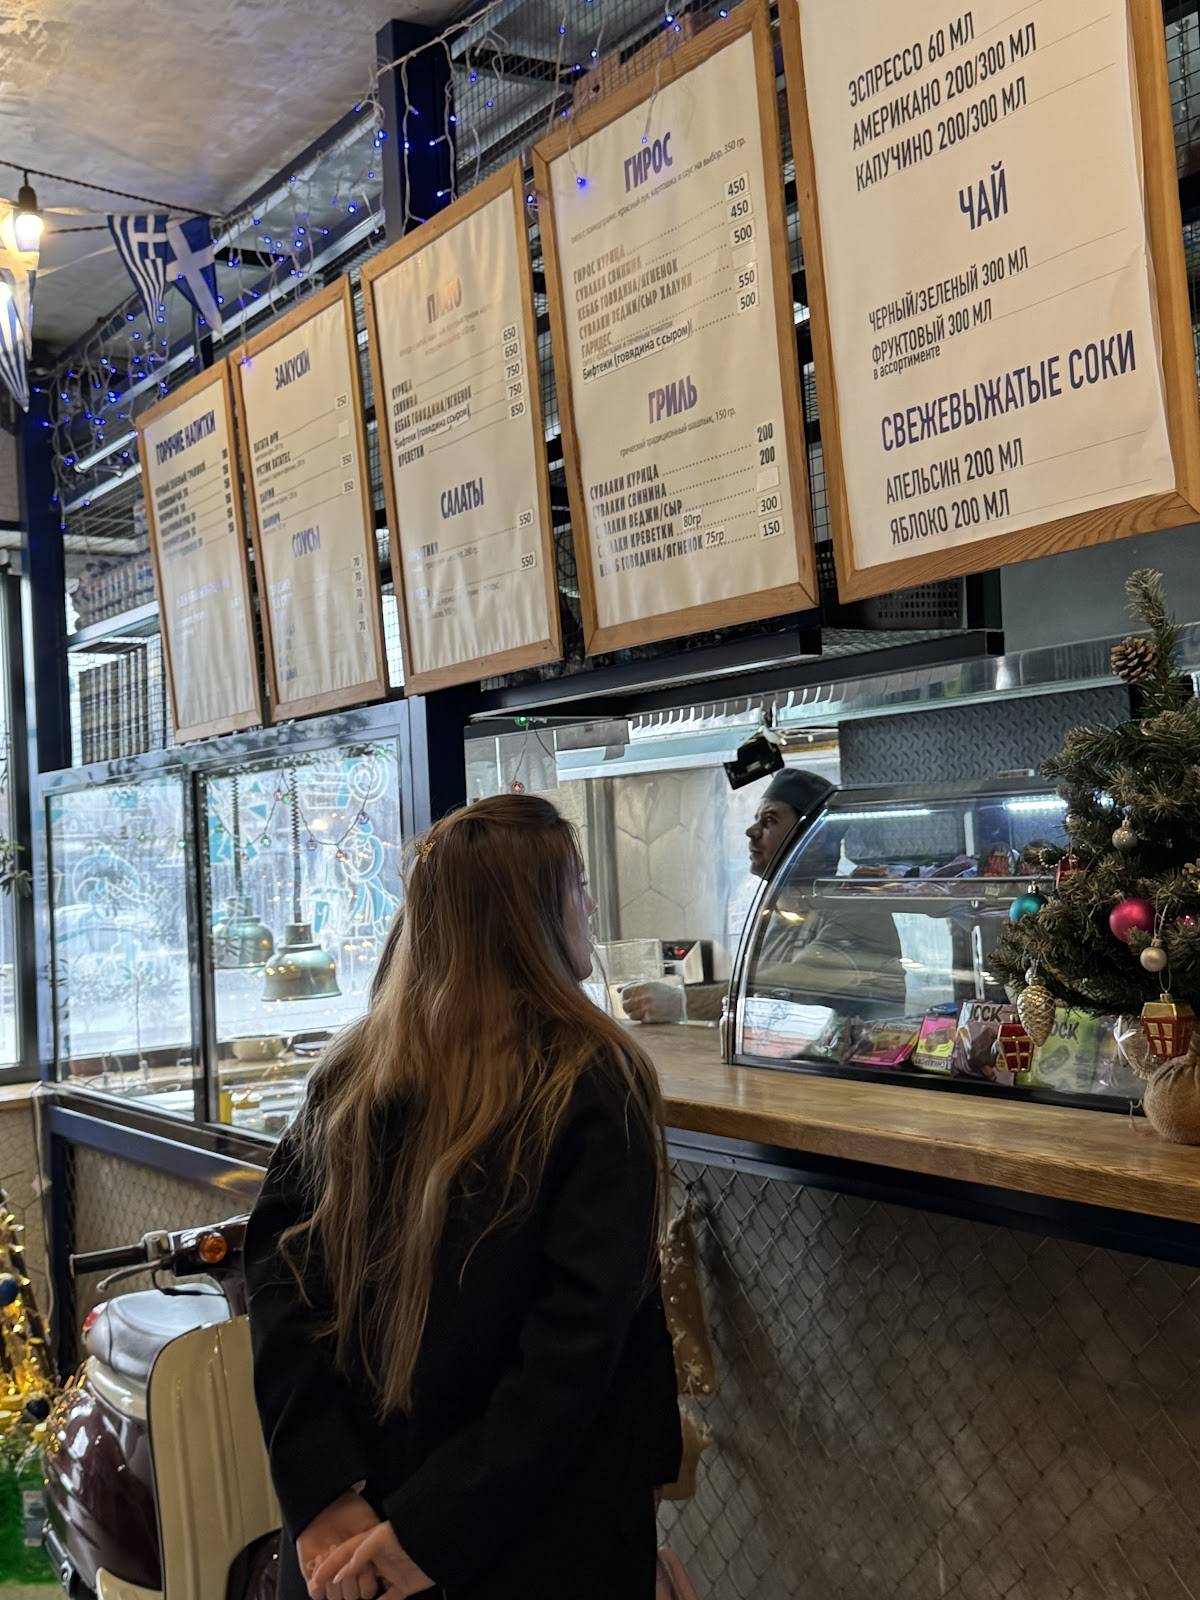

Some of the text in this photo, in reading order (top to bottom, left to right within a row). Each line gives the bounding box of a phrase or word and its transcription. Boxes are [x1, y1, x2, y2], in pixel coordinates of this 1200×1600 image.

[848, 11, 975, 108] ЭСПРЕССО 60 МЛ
[852, 22, 1037, 151] АМЕРИКАНО 200/300 МЛ
[855, 76, 1028, 192] КАПУЧИНО 200/300 МЛ
[624, 131, 673, 193] ГИРОС
[727, 177, 746, 197] 450
[958, 160, 1008, 230] ЧАЙ
[731, 199, 749, 219] 450
[733, 224, 752, 244] 500
[738, 270, 755, 289] 550
[868, 246, 1029, 332] ЧЕРНЫЙ/ЗЕЛЕНЫЙ 300 МЛ
[740, 291, 756, 310] 500
[503, 326, 516, 342] 650
[872, 299, 993, 364] ФРУКТОВЫЙ 300 МЛ
[505, 342, 518, 358] 650
[582, 358, 613, 380] Бифтеки
[614, 341, 655, 368] (говядина
[873, 344, 941, 380] в ассортименте
[506, 362, 520, 378] 750
[508, 382, 522, 397] 750
[648, 375, 698, 424] ГРИЛЬ
[881, 330, 1136, 452] СВЕЖЕВЫЖАТЫЕ СОКИ
[510, 402, 524, 417] 850
[756, 422, 774, 443] 200
[759, 446, 776, 466] 200
[590, 463, 659, 501] СУВЛАКИ КУРИЦА
[886, 437, 1024, 505] АПЕЛЬСИН 200 МЛ
[440, 477, 484, 519] САЛАТЫ
[628, 483, 667, 509] СВИНИНА
[760, 495, 778, 513] 300
[519, 512, 532, 526] 550
[629, 499, 683, 529] ВЕДЖИ/СЫР
[683, 513, 702, 530] 80гр
[890, 488, 1009, 545] ЯБЛОКО 200 МЛ
[630, 522, 674, 548] КРЕВЕТКИ
[705, 531, 724, 545] 75гр
[763, 520, 781, 537] 150
[521, 554, 534, 569] 550
